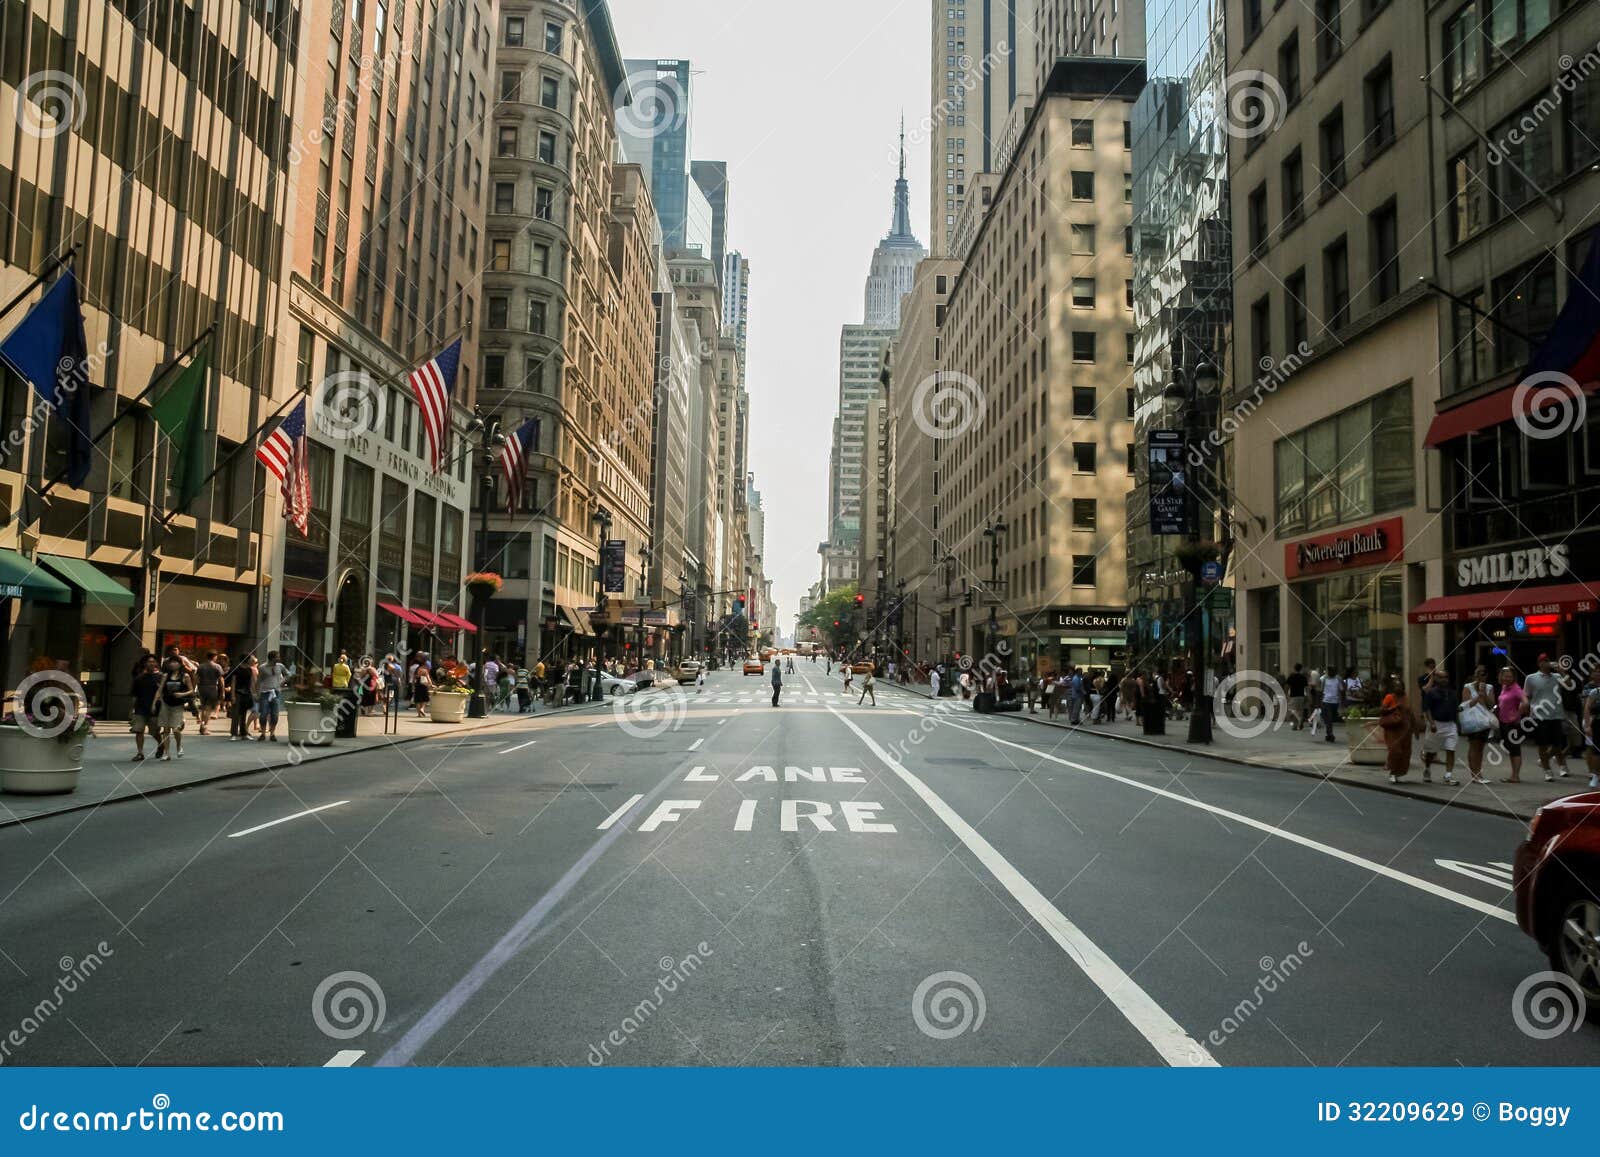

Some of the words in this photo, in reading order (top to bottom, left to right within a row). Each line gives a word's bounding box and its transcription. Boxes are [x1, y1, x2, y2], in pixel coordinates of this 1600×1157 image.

[388, 451, 419, 481] FRENCH
[1305, 538, 1351, 564] Sovereign
[1353, 529, 1383, 554] Bank
[1457, 544, 1570, 588] SMILER'S
[684, 766, 867, 783] LANE
[637, 800, 898, 833] FIRE
